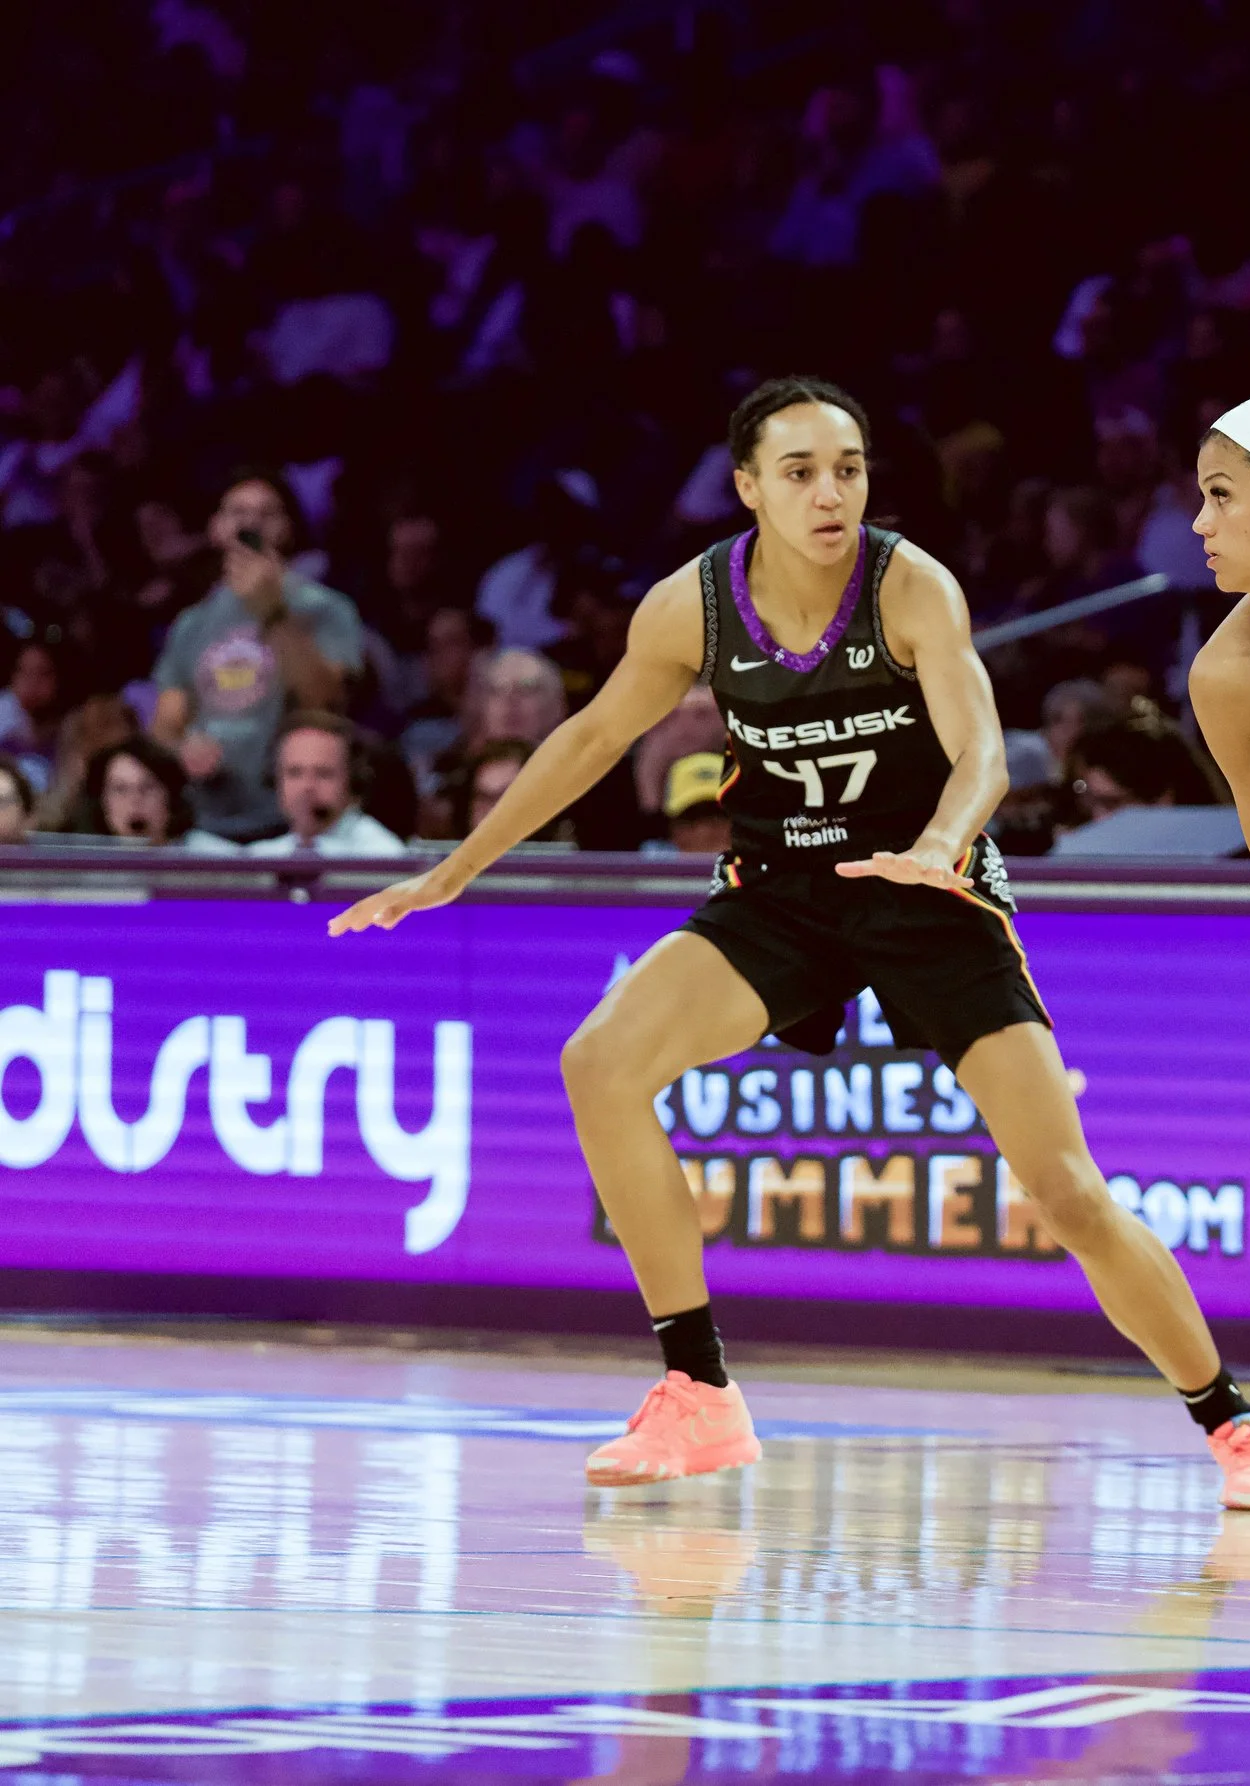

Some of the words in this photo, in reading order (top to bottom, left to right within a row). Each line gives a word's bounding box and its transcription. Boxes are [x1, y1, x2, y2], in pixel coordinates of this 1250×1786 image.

[727, 704, 917, 751] KEESUSK
[762, 749, 878, 808] 47
[784, 825, 849, 848] Health
[653, 1062, 988, 1136] USINES
[640, 1153, 1060, 1250] UMMER
